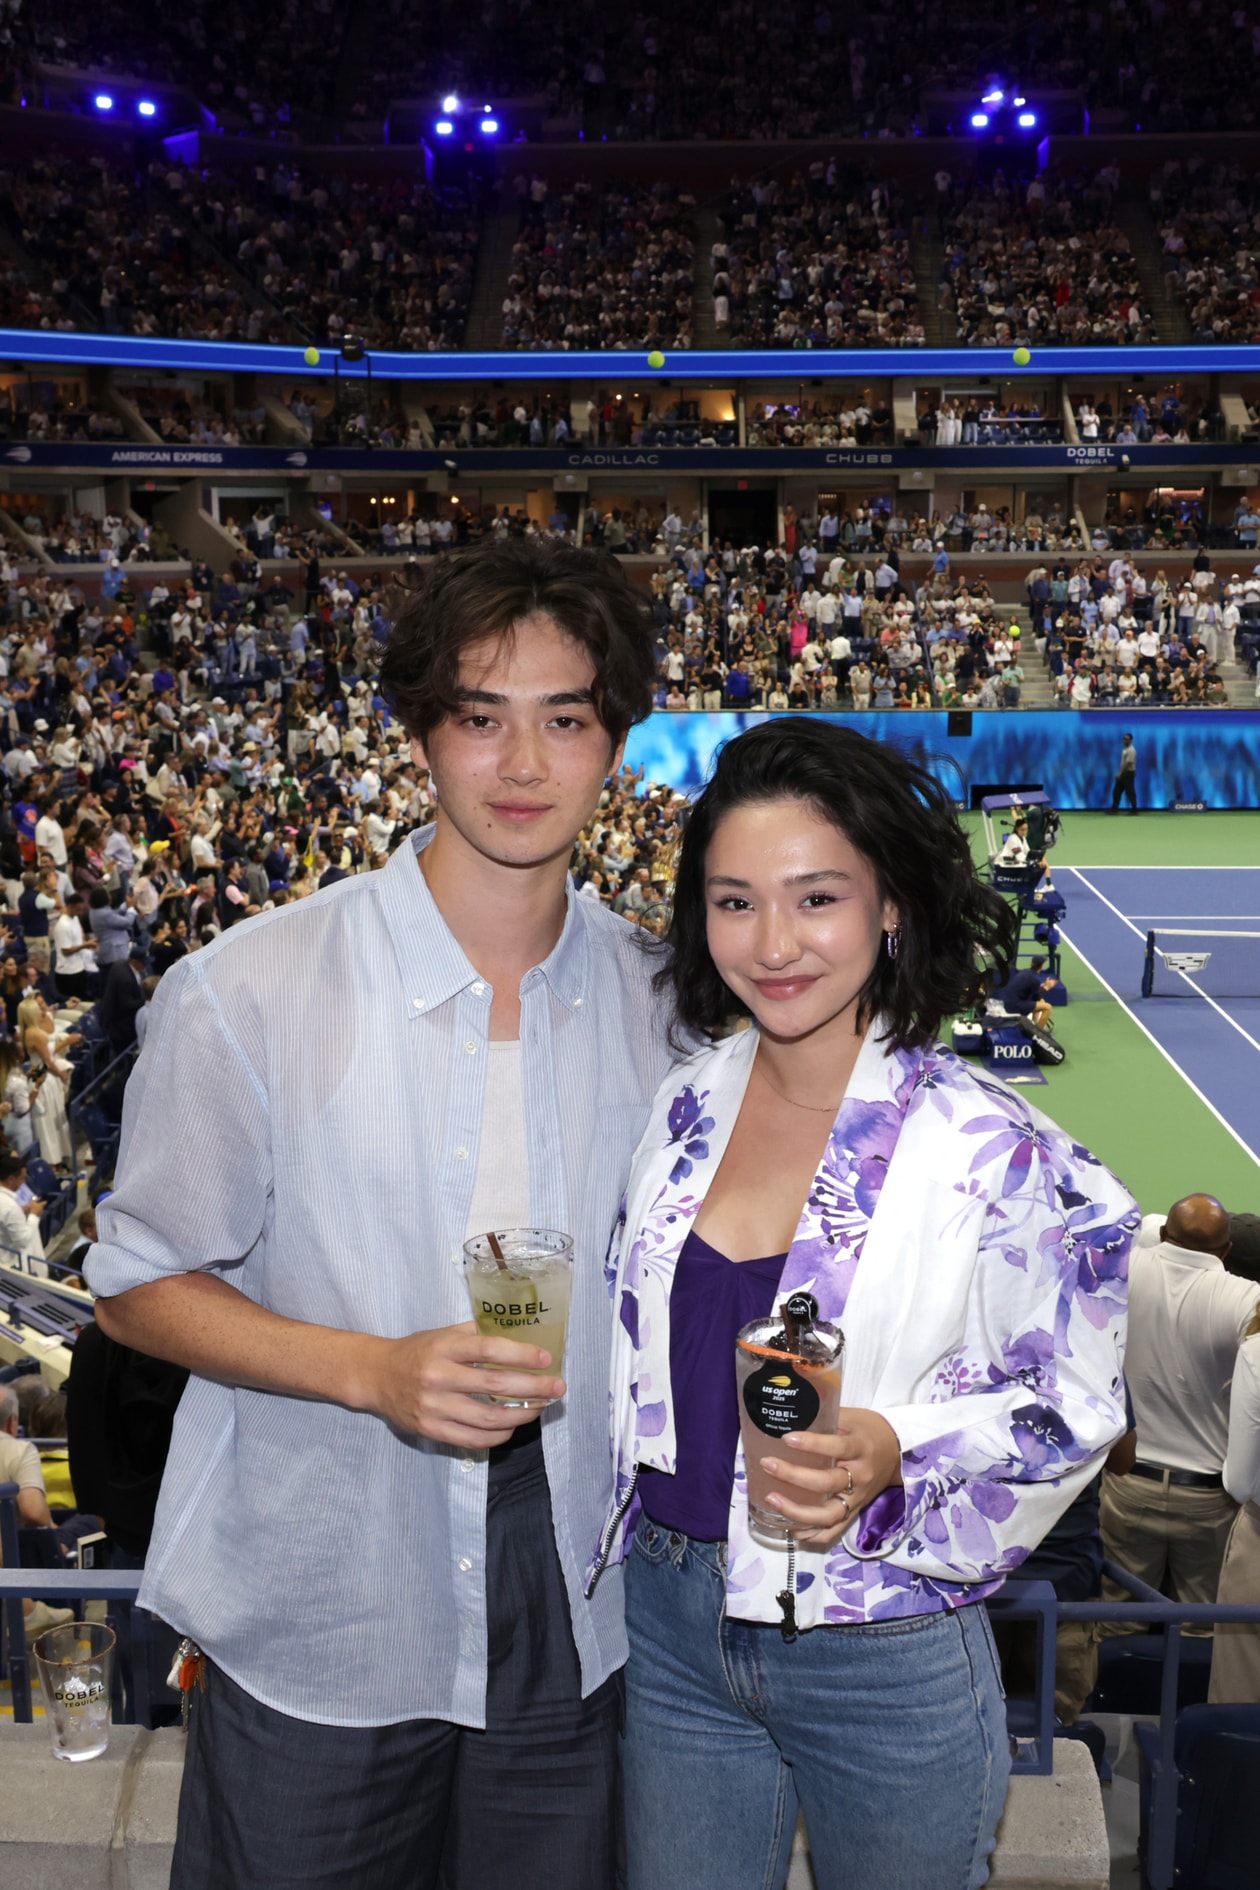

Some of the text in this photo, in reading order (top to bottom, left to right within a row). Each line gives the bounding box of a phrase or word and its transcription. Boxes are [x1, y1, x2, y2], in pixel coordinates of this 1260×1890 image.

[112, 451, 223, 463] AMERICAN EXPRESS
[1067, 447, 1115, 457] DOBEL
[568, 454, 660, 465] CADILLAC
[826, 453, 893, 464] CHUBB
[993, 1045, 1033, 1059] POLO
[1032, 1034, 1064, 1061] HEAD
[482, 1301, 549, 1316] DOBEL
[493, 1317, 541, 1327] TEQUILA
[773, 1388, 797, 1397] open
[761, 1407, 798, 1419] DOBEL
[55, 1685, 105, 1701] DOBEL
[64, 1696, 99, 1708] TEQUILA
